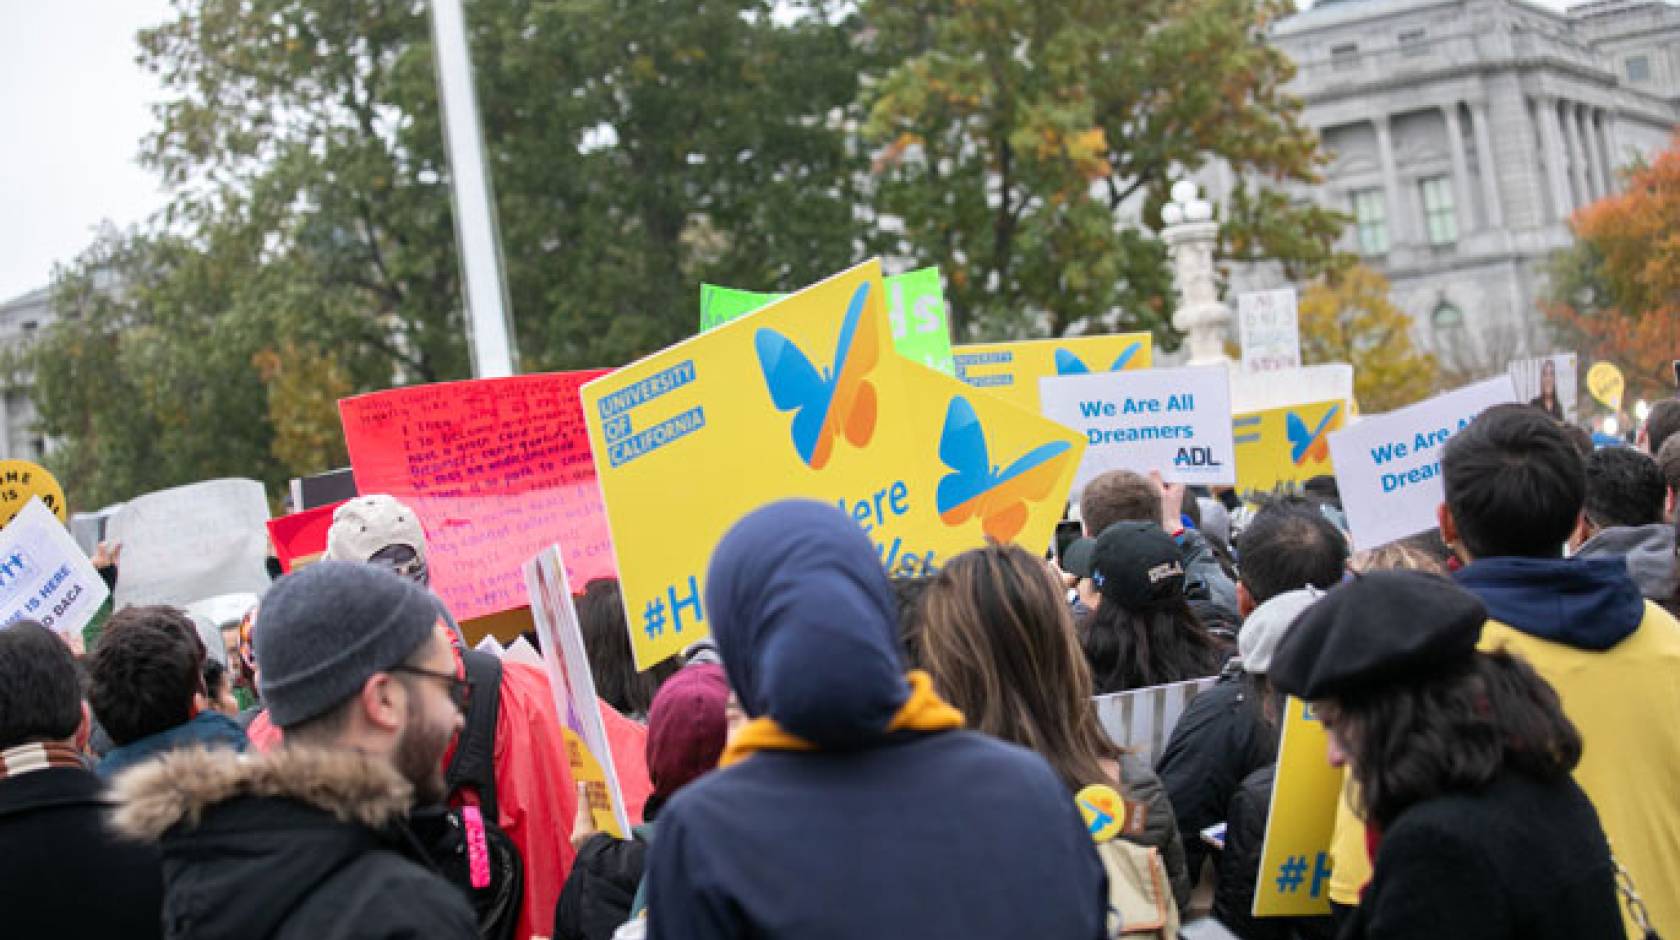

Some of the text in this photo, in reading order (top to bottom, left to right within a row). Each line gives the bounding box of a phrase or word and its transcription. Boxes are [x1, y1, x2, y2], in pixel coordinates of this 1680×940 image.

[599, 361, 694, 418] UNIVERSITY
[1080, 394, 1194, 416] We Are All
[605, 416, 630, 441] OF
[608, 407, 704, 465] CALIFORNIA
[1087, 425, 1193, 446] Dreamers
[1173, 447, 1223, 466] ADL
[1371, 428, 1450, 465] We Are
[39, 565, 71, 599] HERE
[53, 584, 83, 617] DACA
[643, 574, 704, 640] #H
